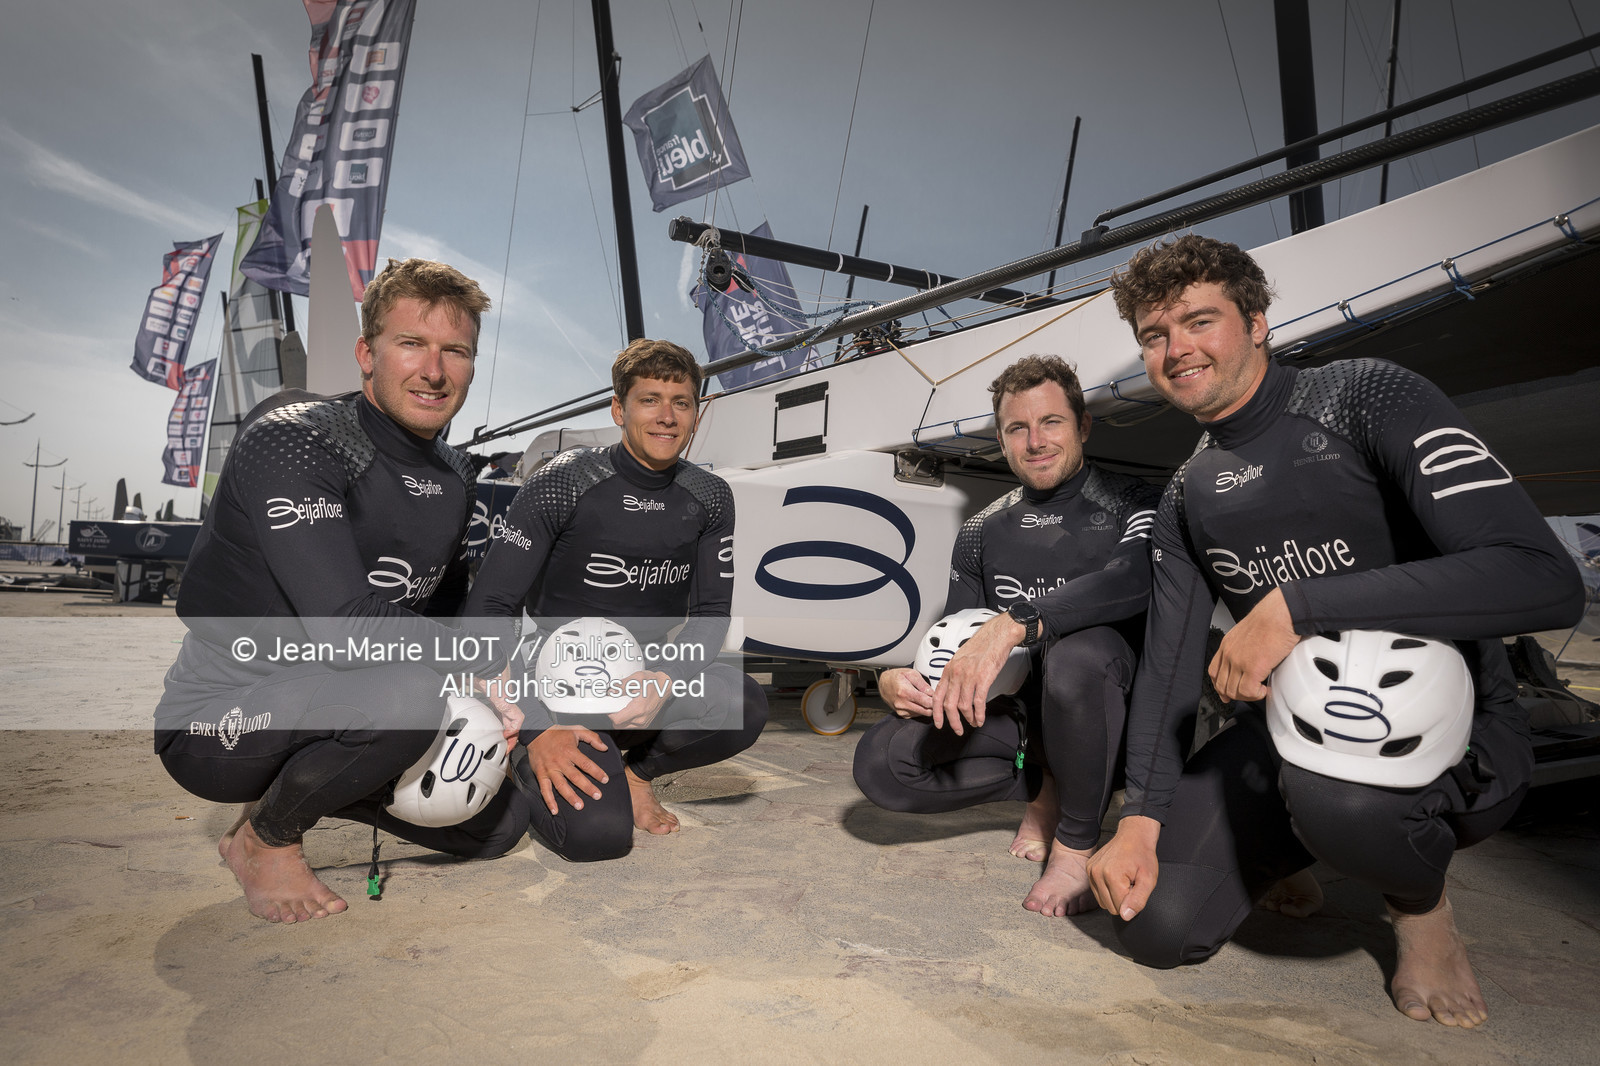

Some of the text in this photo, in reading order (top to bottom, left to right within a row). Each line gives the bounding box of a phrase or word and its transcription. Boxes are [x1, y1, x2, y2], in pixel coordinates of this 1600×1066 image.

[1316, 453, 1341, 462] LLOYD
[1215, 464, 1264, 493] Beijaflore
[266, 497, 343, 530] Beijaflore
[623, 495, 666, 513] Beijaflore
[583, 552, 691, 591] Beijaflore
[1206, 538, 1356, 595] Beijaflore
[185, 711, 272, 737] ENRI LLOYD
